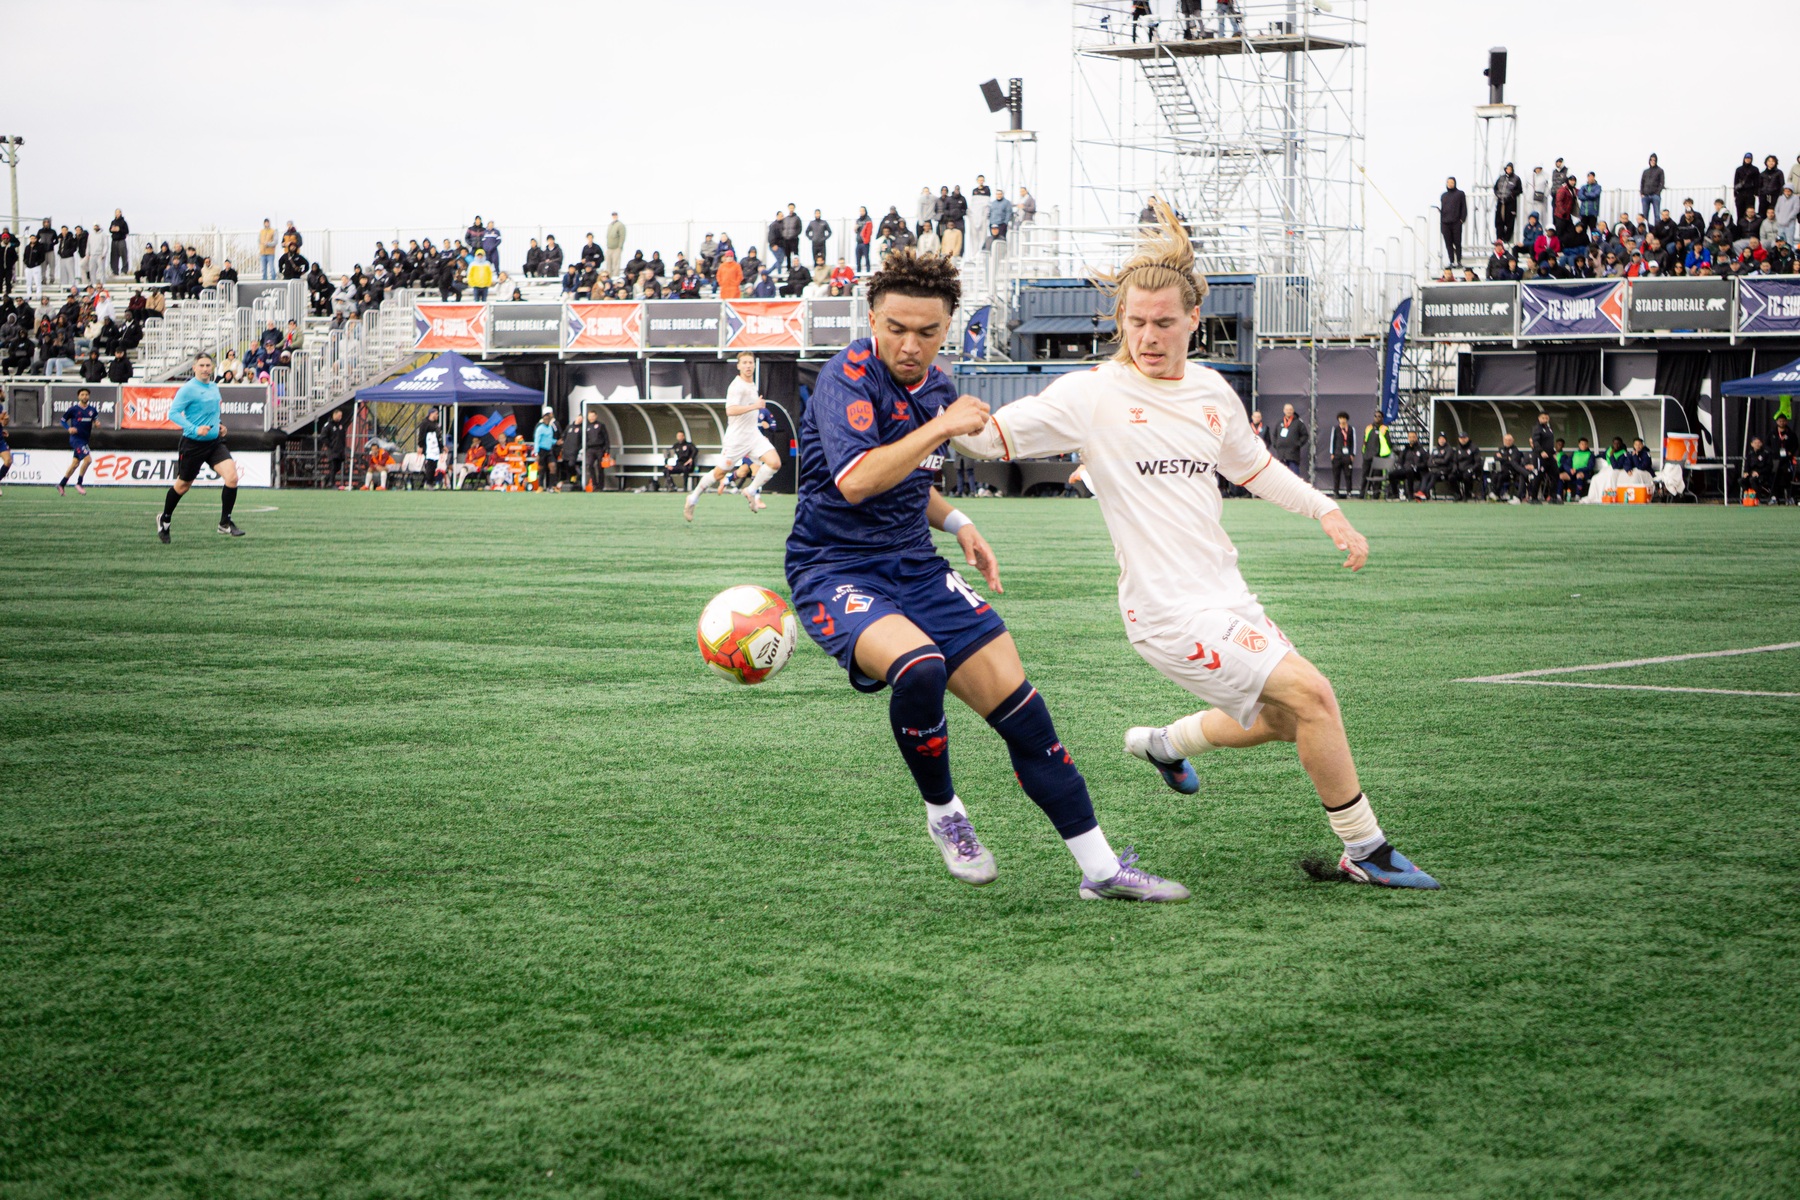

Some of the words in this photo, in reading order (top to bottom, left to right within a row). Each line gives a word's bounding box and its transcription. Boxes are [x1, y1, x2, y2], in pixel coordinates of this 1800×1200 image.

[1425, 303, 1451, 317] STADE
[1452, 302, 1490, 317] BORÉALE
[1548, 299, 1561, 320] FC
[1561, 298, 1596, 320] SUPRA
[1635, 299, 1663, 312] STADE
[1664, 297, 1705, 312] BORÉALE
[1768, 294, 1781, 316] FC
[746, 315, 757, 334] FC
[136, 398, 149, 421] FC
[94, 454, 132, 480] EB
